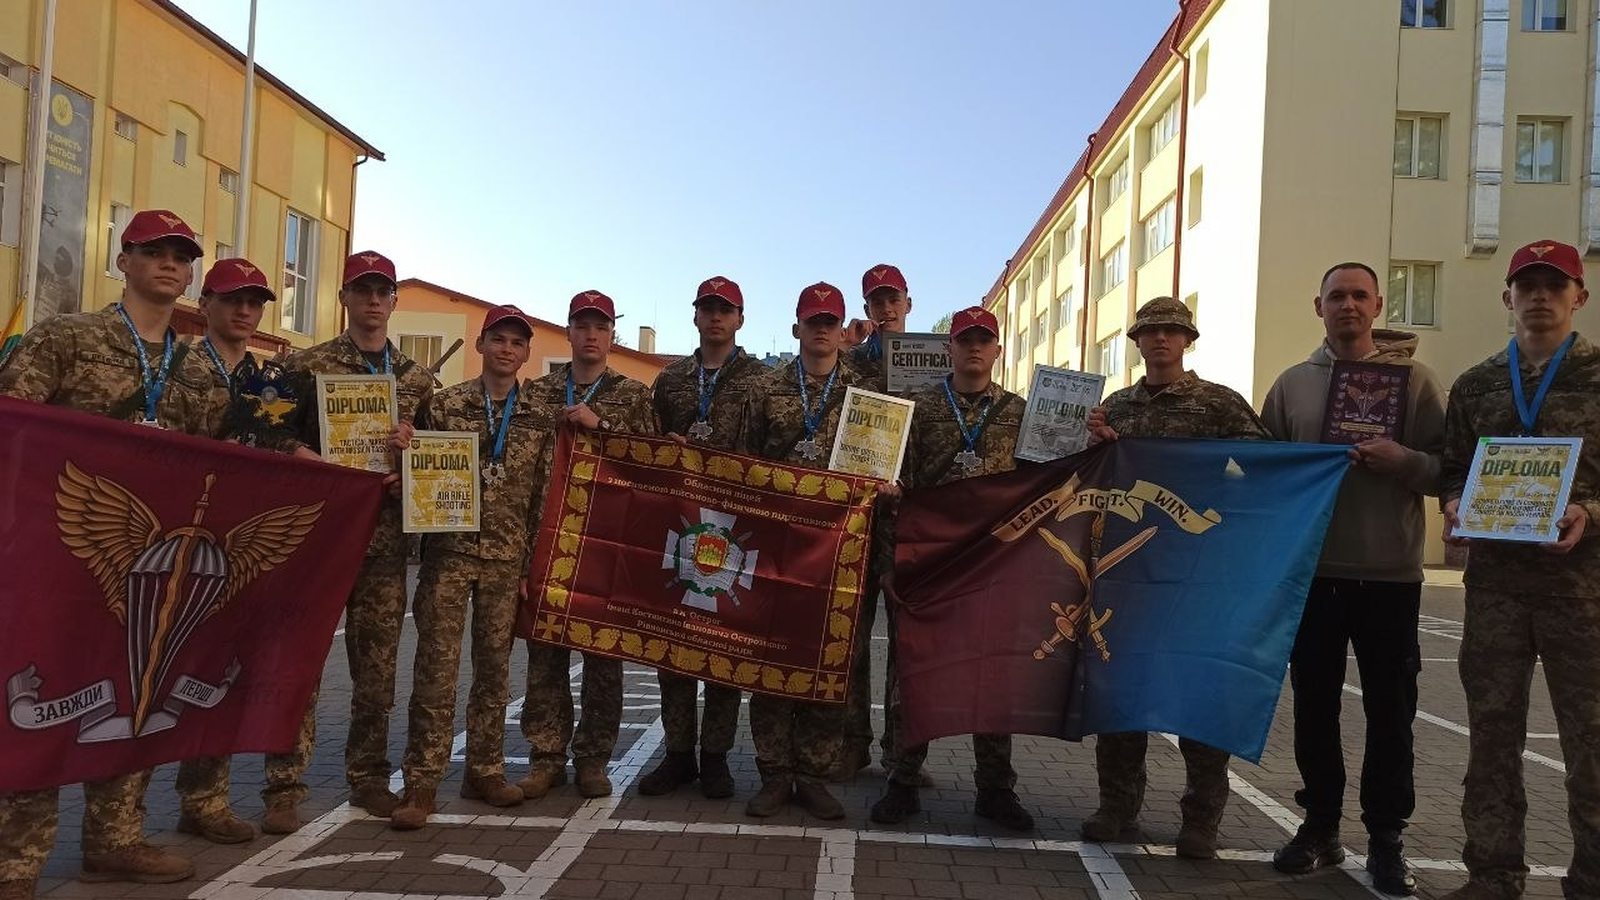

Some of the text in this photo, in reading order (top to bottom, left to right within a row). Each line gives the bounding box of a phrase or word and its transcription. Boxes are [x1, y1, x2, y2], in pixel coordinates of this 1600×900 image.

[892, 352, 953, 368] CERTIFICAT
[326, 397, 388, 415] DIPLOMA
[1036, 397, 1087, 420] DIPLOMA
[847, 408, 901, 434] DIPLOMA
[411, 453, 470, 471] DIPLOMA
[1480, 459, 1561, 477] DIPLOMA
[437, 490, 471, 501] AIR RIFLE
[435, 500, 471, 510] SHOOTING
[1010, 489, 1190, 533] LEAD. FIGT. WIN.
[689, 611, 721, 626] Острог
[682, 621, 729, 639] Івановича
[33, 679, 215, 725] ЗАВЖДИ ПЕРШІ
